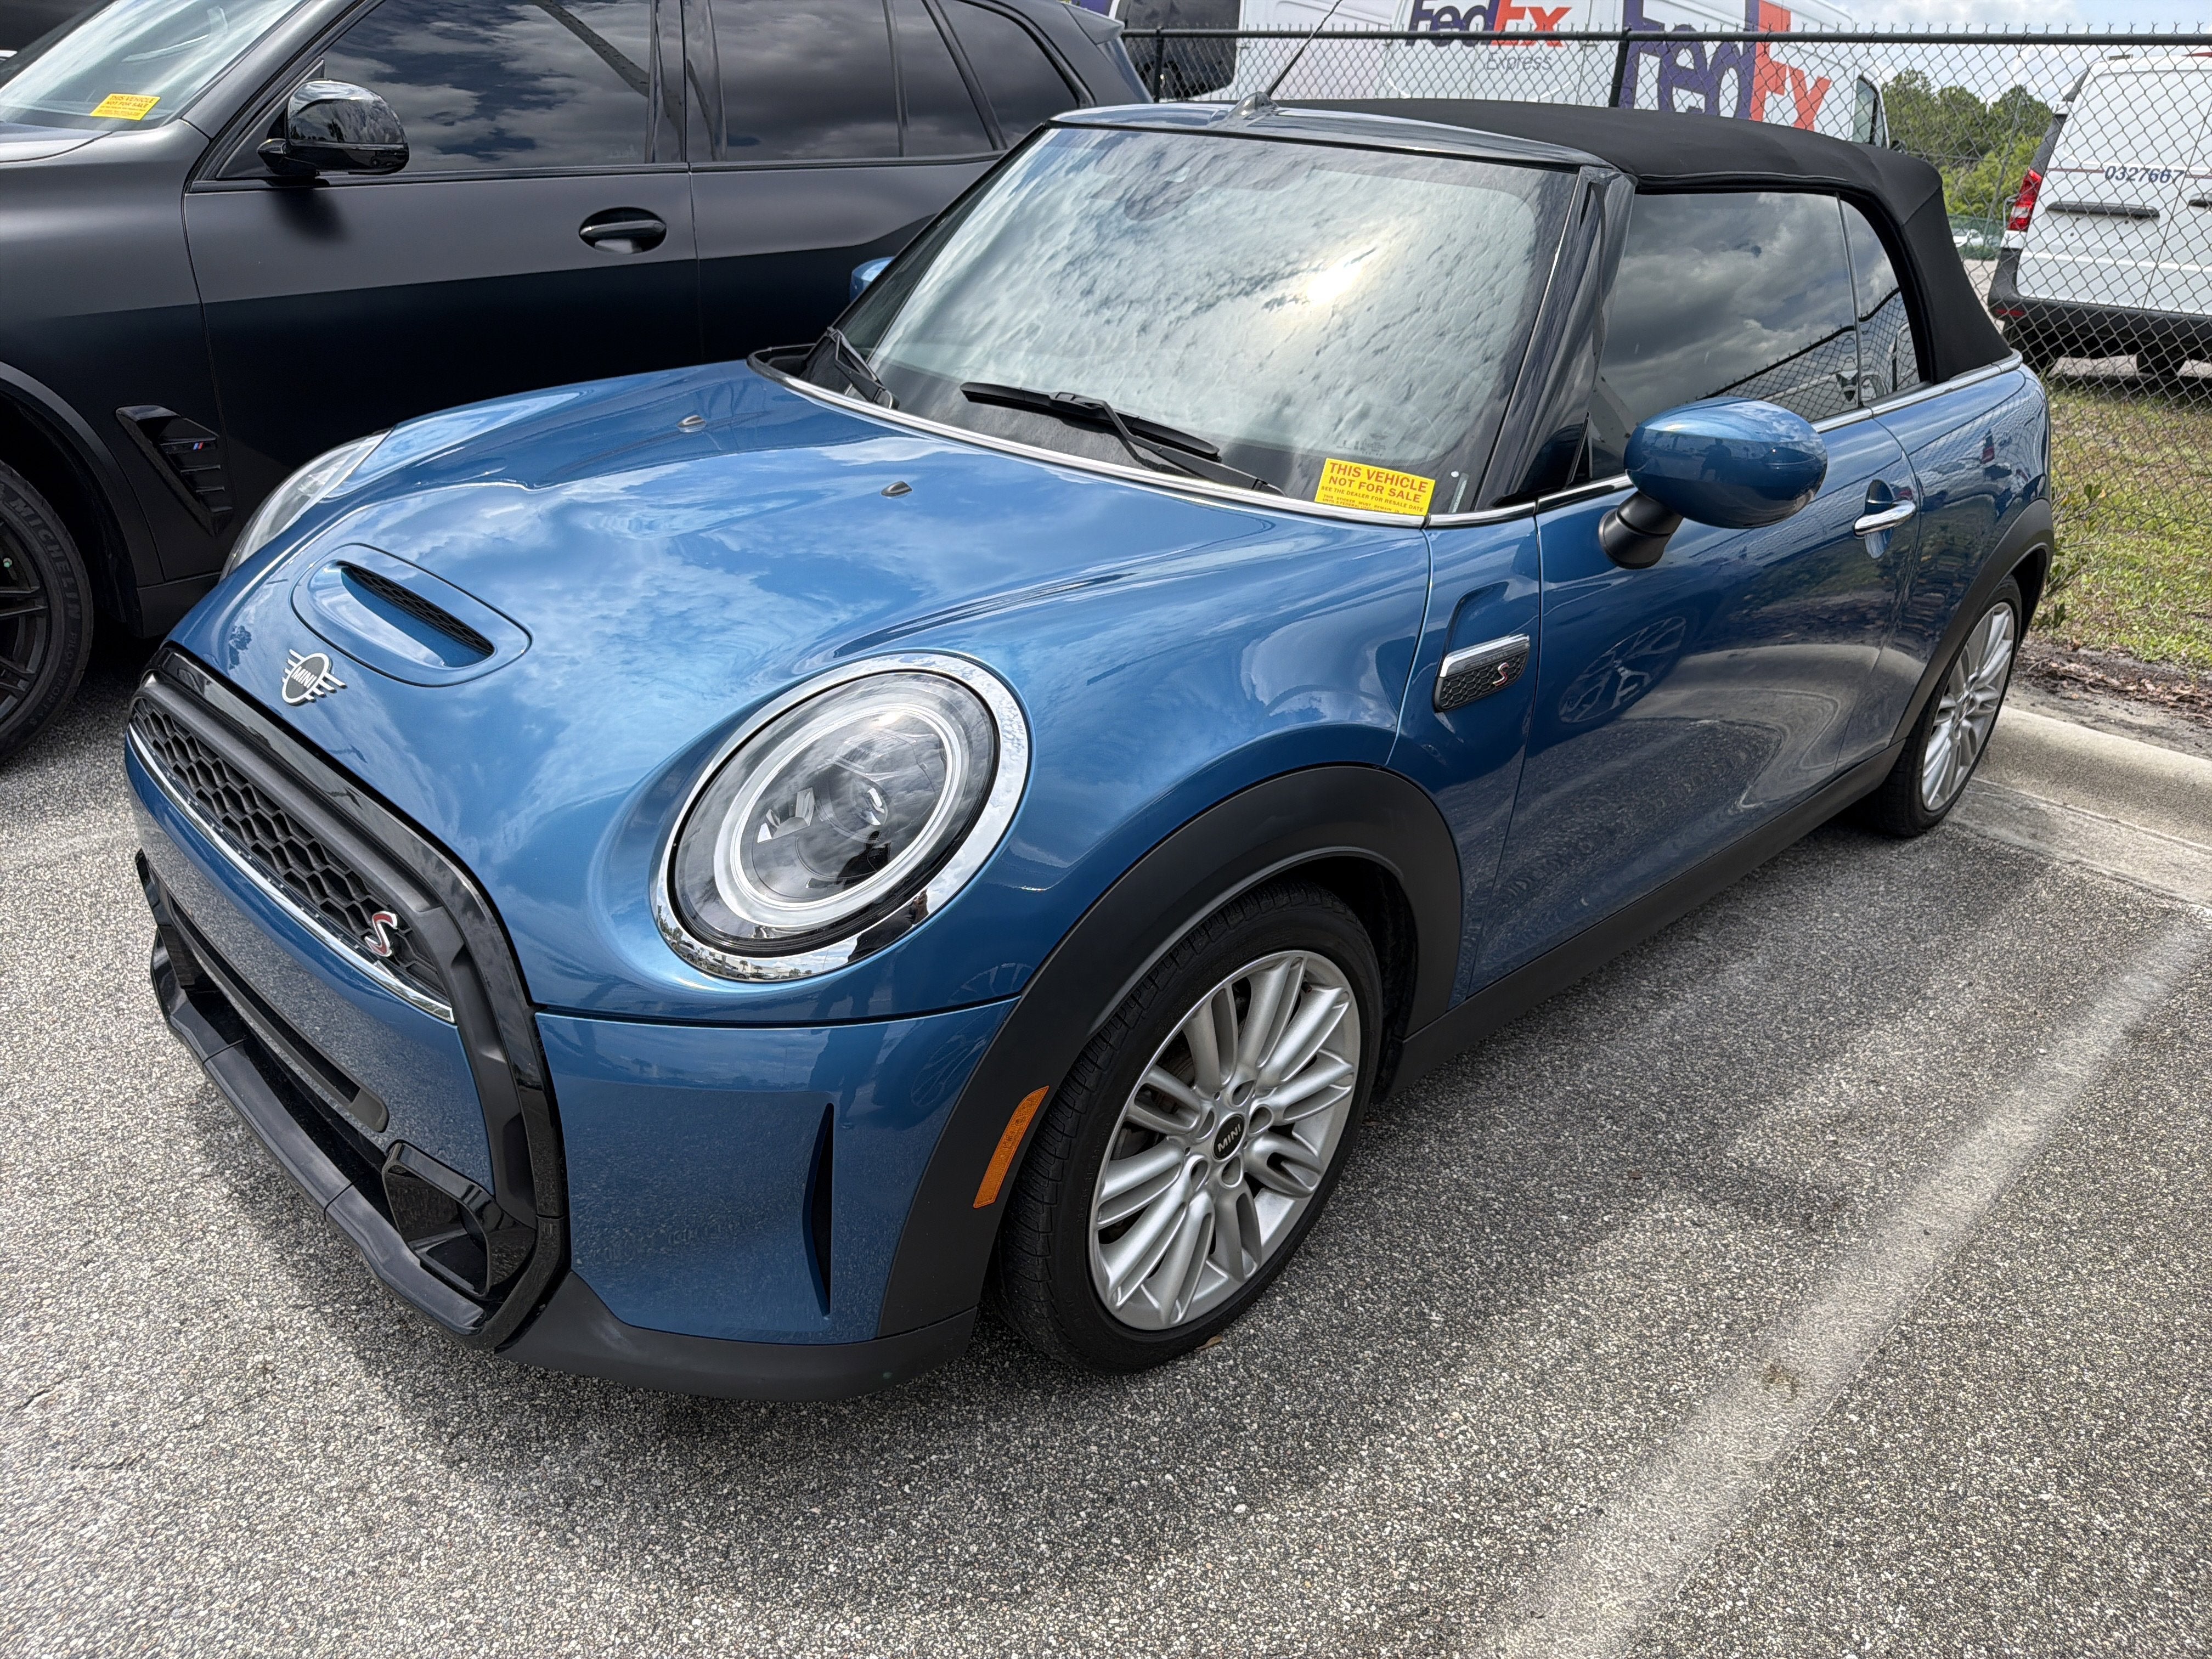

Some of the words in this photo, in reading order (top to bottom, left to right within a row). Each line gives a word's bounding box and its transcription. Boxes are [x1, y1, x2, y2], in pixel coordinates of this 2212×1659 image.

[1405, 0, 1572, 47] FedEx
[1486, 53, 1552, 74] Express
[1618, 0, 1832, 132] FedEx
[1328, 476, 1356, 488] NOT
[1358, 481, 1385, 494] FOR
[1387, 488, 1422, 503] SALE
[1329, 462, 1362, 478] THIS
[1367, 469, 1429, 493] VEHICLE
[1346, 490, 1370, 499] DEALER
[1384, 499, 1408, 508] RESALE
[1408, 504, 1424, 512] DATE
[9, 497, 82, 619] MICHELIN
[291, 665, 317, 689] MINI
[364, 911, 398, 957] S
[1217, 1123, 1242, 1153] MINI
